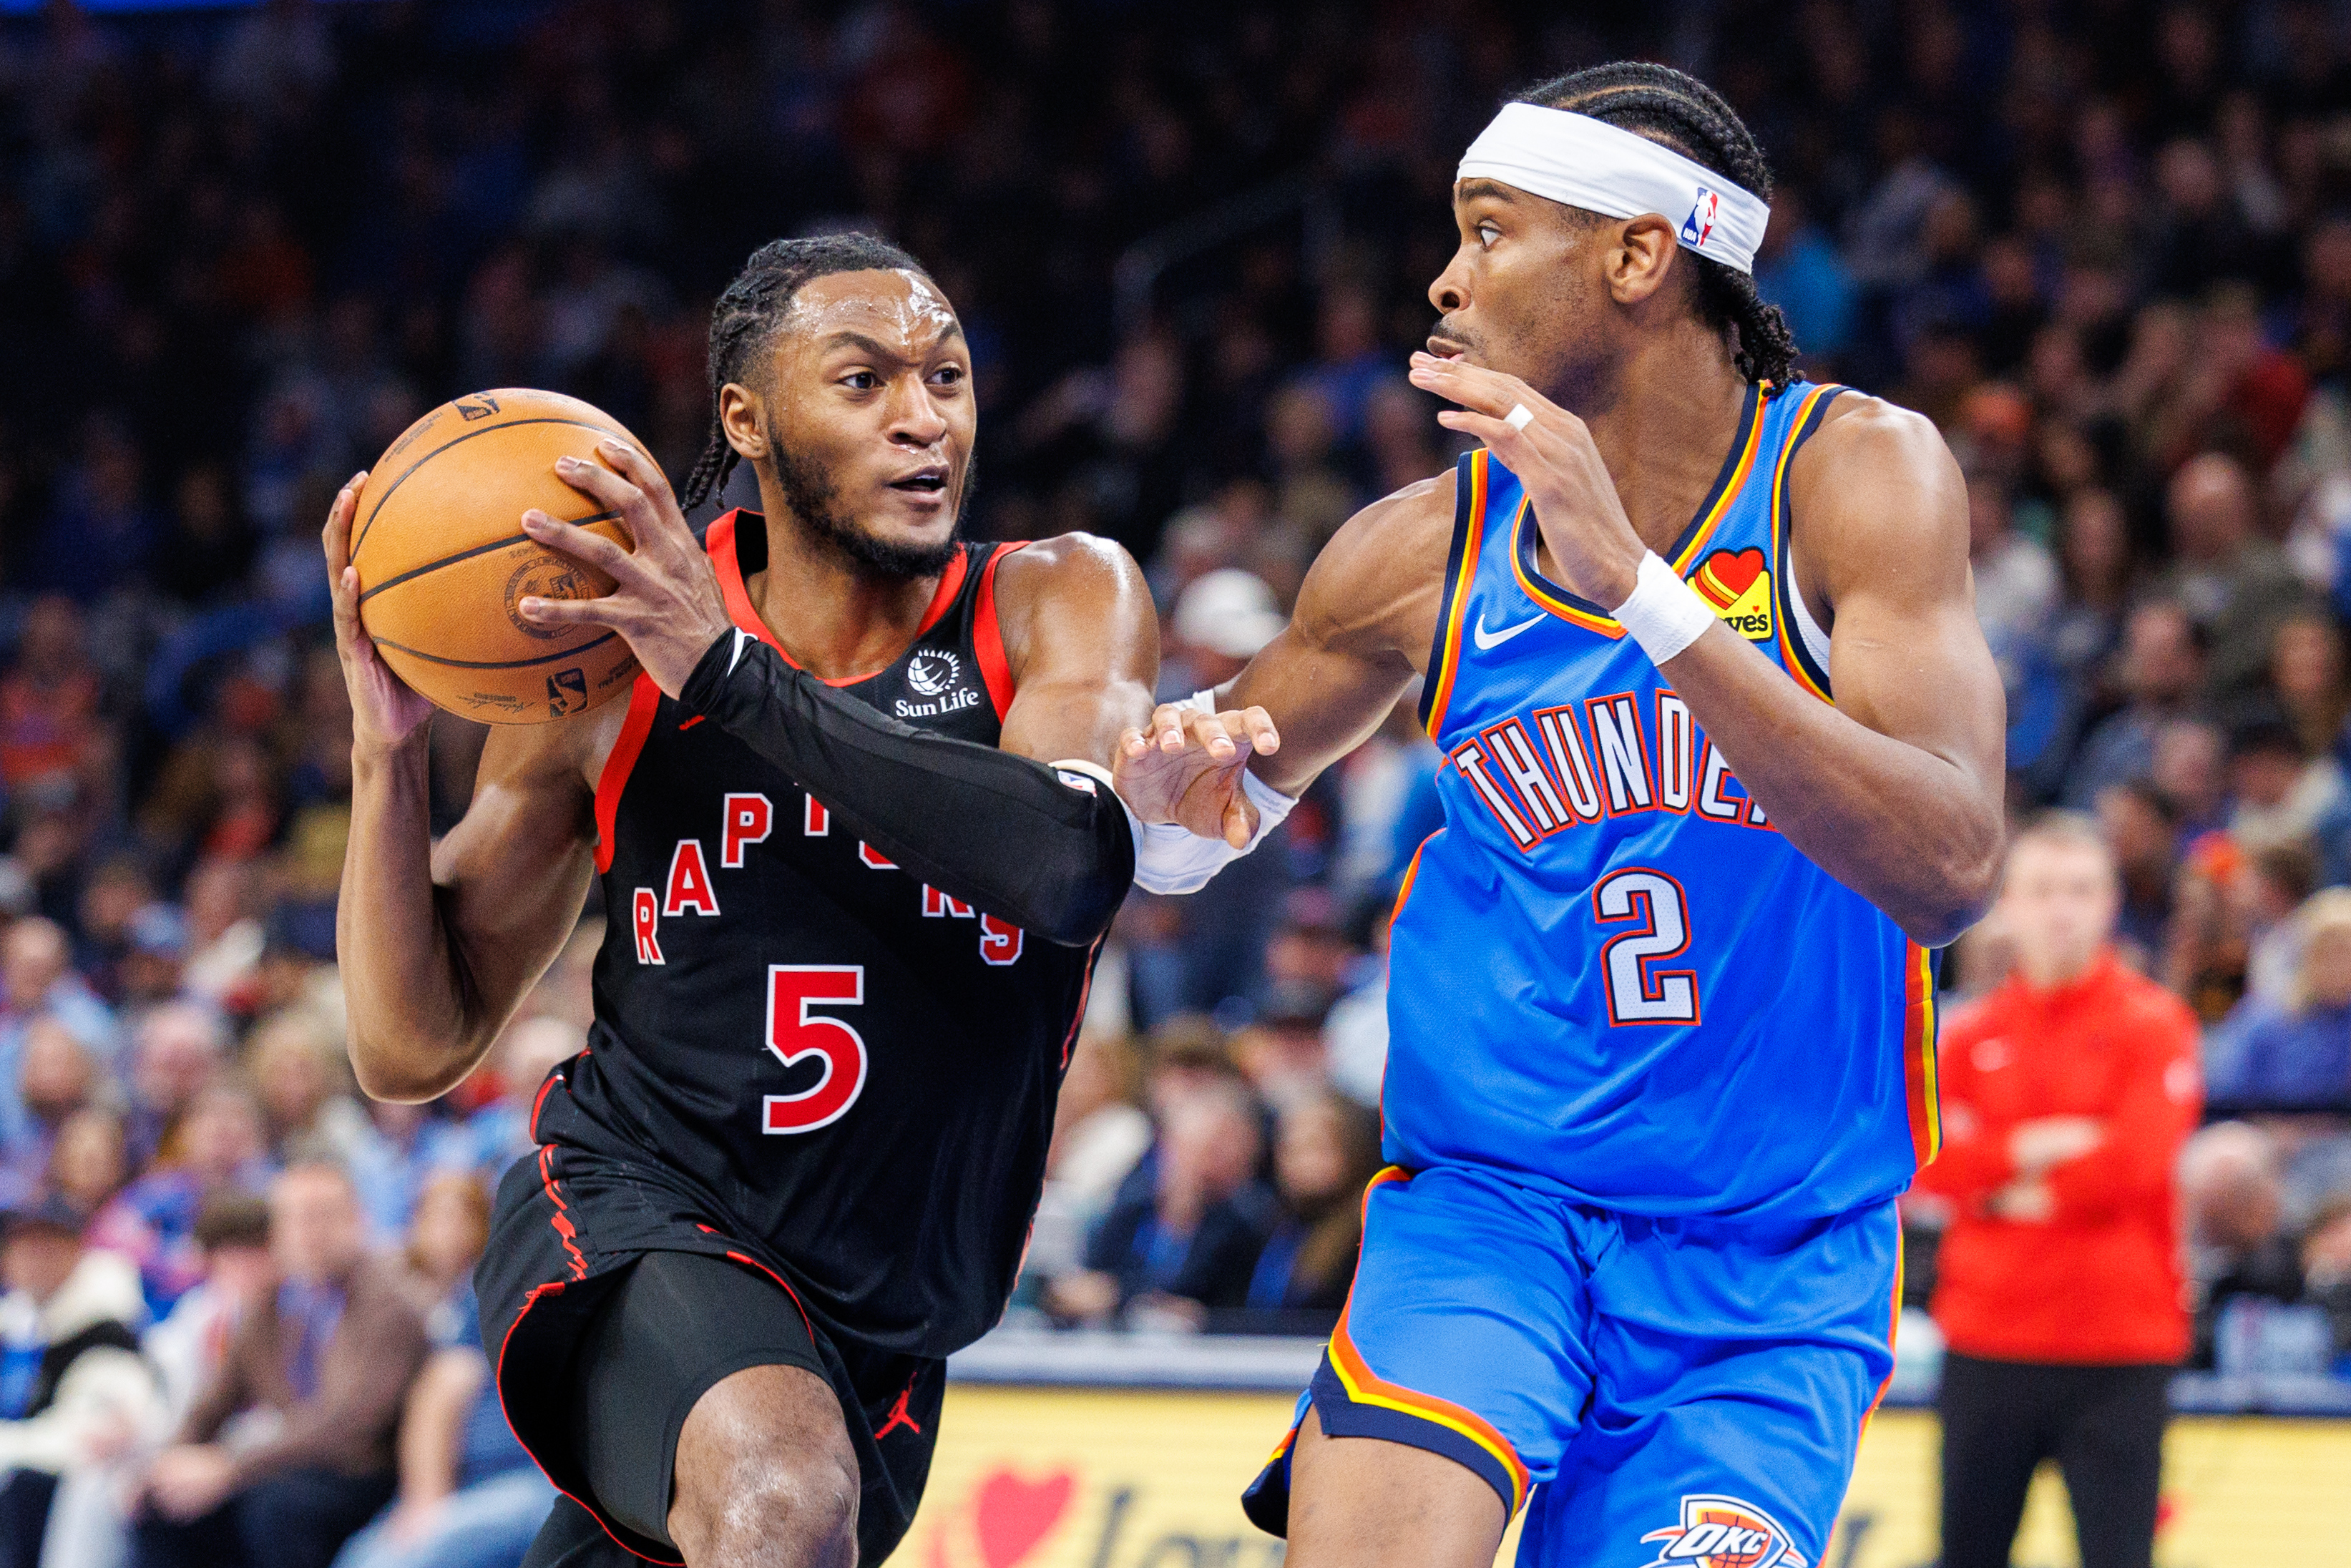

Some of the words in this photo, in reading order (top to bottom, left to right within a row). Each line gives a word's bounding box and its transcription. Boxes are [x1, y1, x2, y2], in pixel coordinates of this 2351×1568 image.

[1683, 227, 1697, 242] NBA
[1720, 614, 1768, 632] ves
[896, 700, 937, 717] Sun
[939, 687, 979, 713] Life
[1450, 688, 1784, 854] THUNDE
[1592, 866, 1701, 1027] 2
[762, 964, 868, 1135] 5
[1666, 1522, 1769, 1558] OKC
